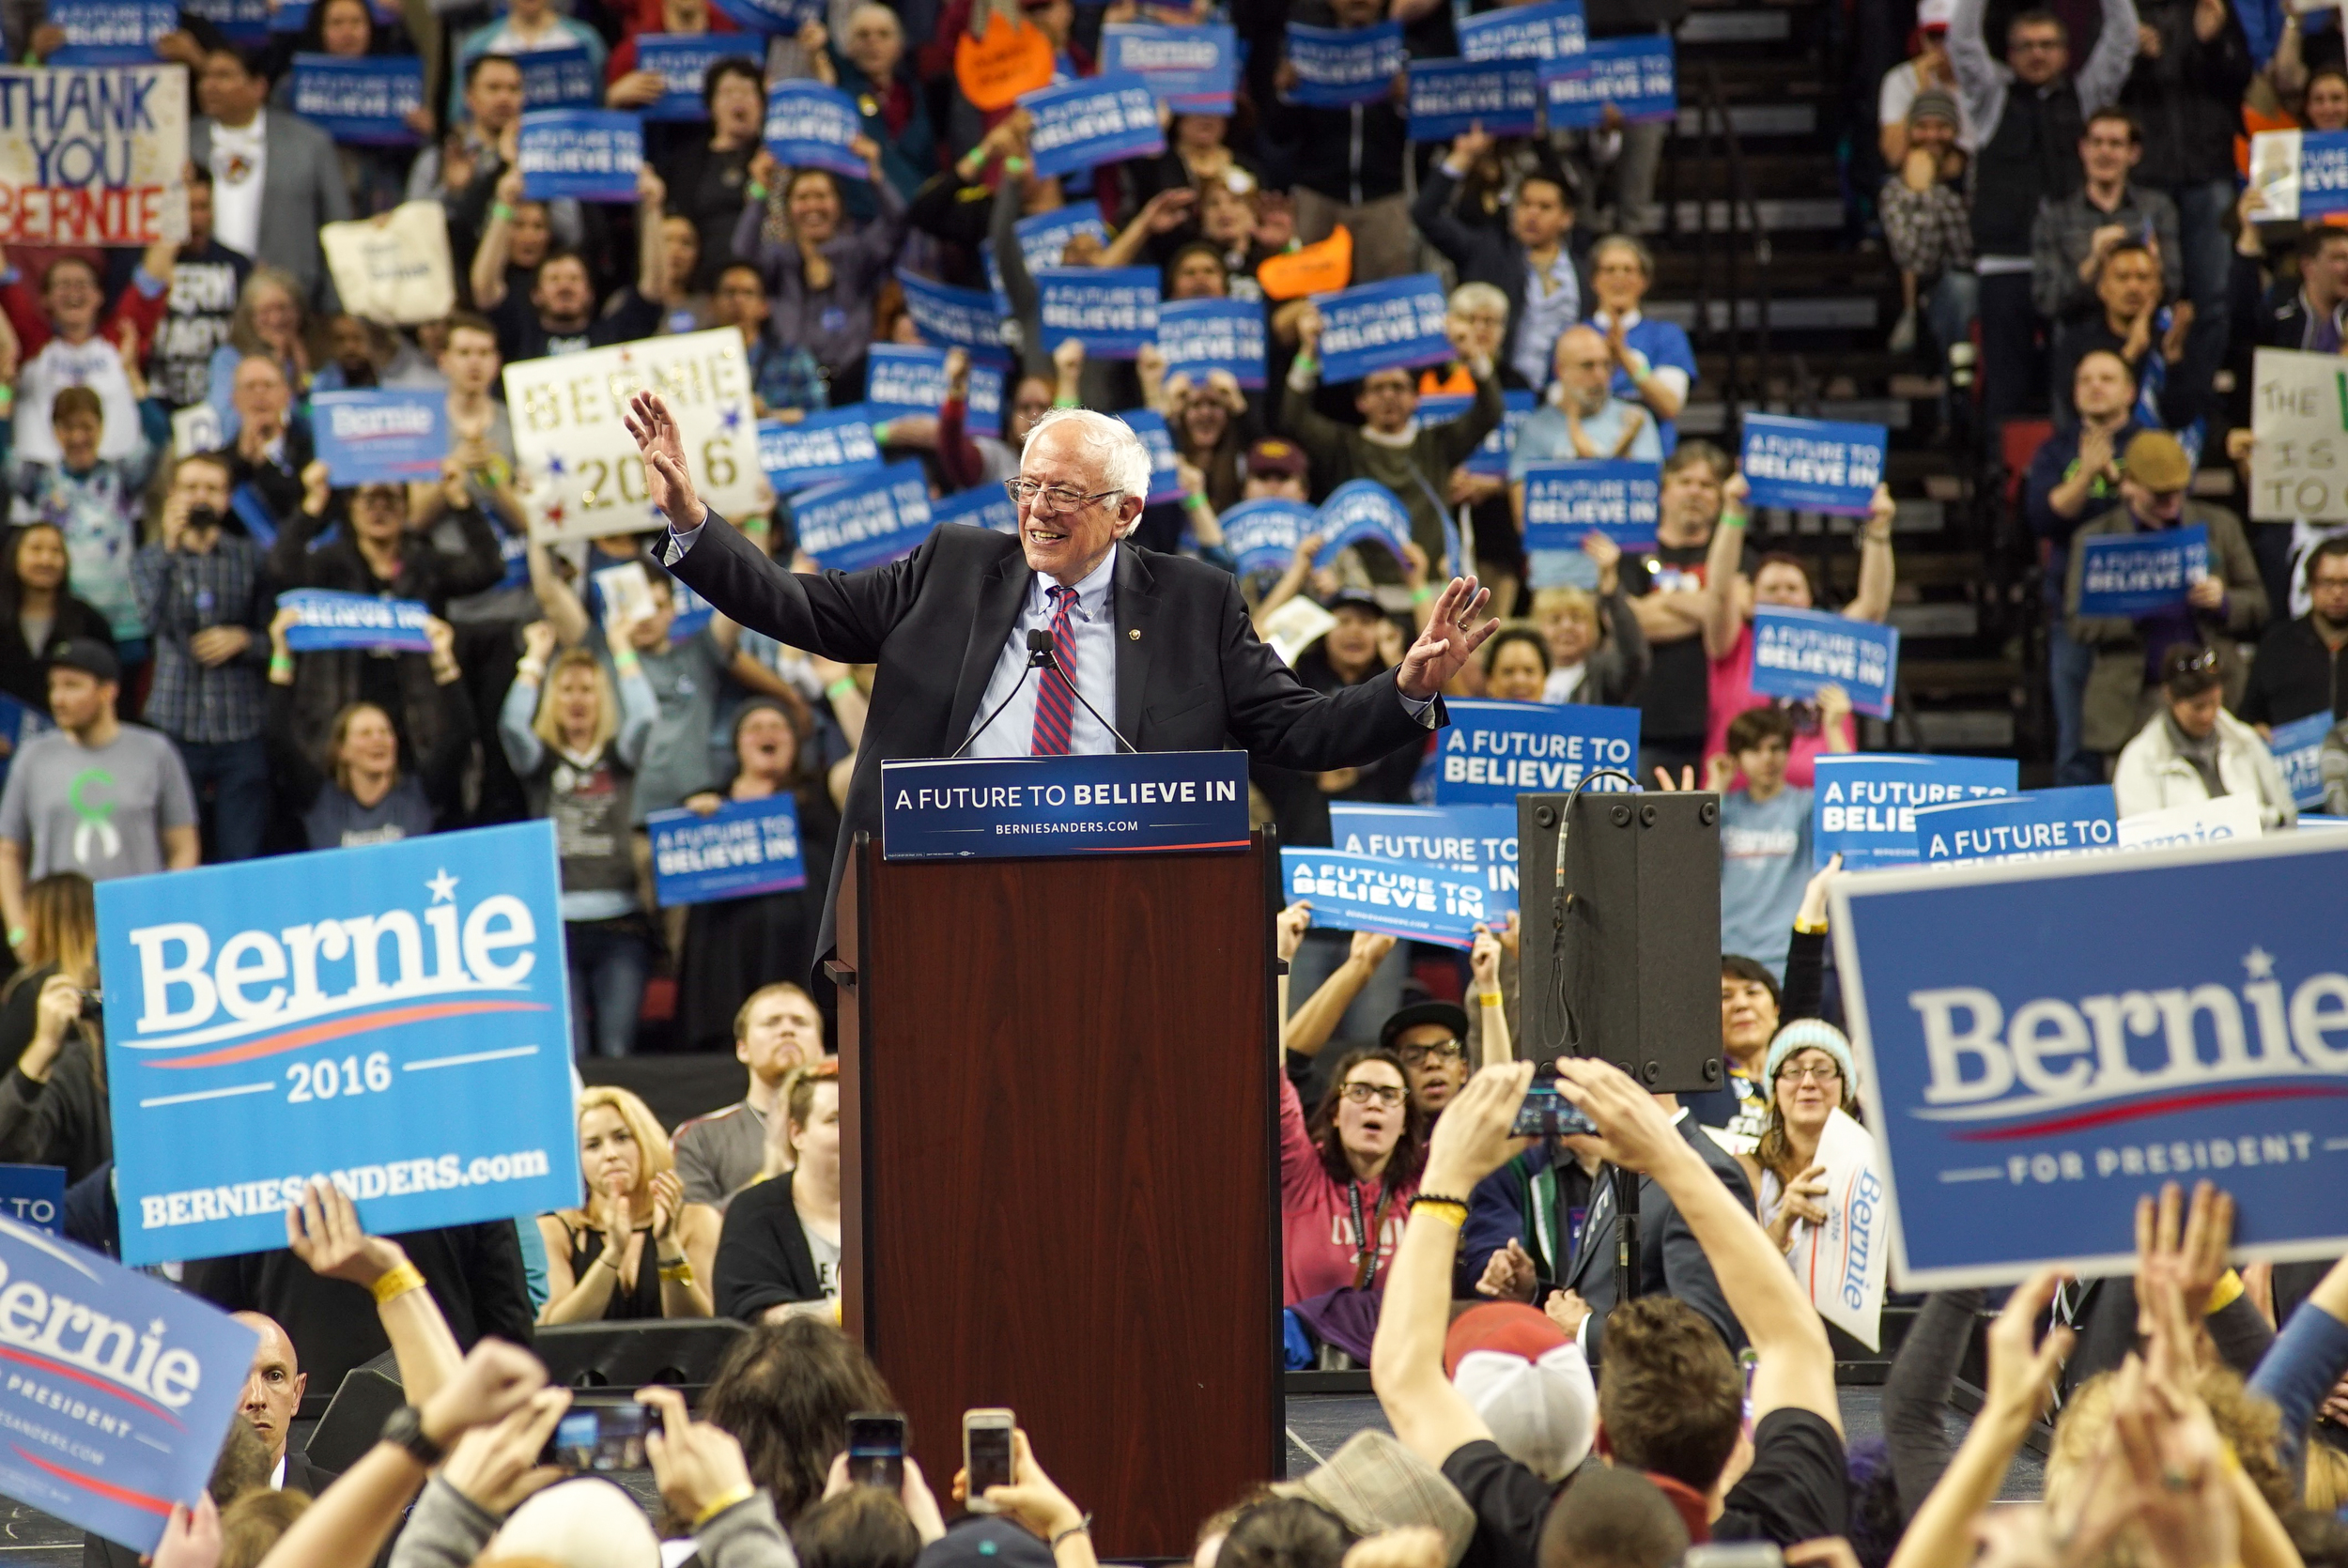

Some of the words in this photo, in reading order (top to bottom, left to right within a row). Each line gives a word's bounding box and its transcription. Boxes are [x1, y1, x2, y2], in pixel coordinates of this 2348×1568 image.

[0, 76, 158, 131] THANK
[30, 136, 132, 189] YOU
[0, 187, 164, 242] BERNIE
[2259, 379, 2320, 419] THE
[1745, 451, 1846, 486] BELIEVE
[1847, 463, 1879, 490] IN
[1766, 435, 1846, 460] FUTURE
[1849, 443, 1881, 467] TO
[2274, 438, 2337, 470] IS
[576, 436, 738, 513] 206
[1527, 500, 1627, 525] BELIEVE
[2263, 476, 2329, 515] TO
[1778, 625, 1857, 655] FUTURE
[1755, 642, 1858, 681] BELIEVE
[1857, 659, 1886, 688] IN
[1446, 729, 1467, 752] A
[1473, 730, 1583, 761] FUTURE
[1589, 737, 1631, 765] TO
[1444, 755, 1583, 791] BELIEVE
[1824, 780, 1845, 805] A
[895, 790, 913, 810] A
[919, 786, 1022, 810] FUTURE
[1028, 785, 1066, 807] TO
[1074, 781, 1197, 806] BELIEVE
[1206, 780, 1236, 802] IN
[673, 818, 758, 850] FUTURE
[761, 814, 796, 837] TO
[996, 820, 1138, 835] BERNIESANDERS.COM
[1822, 807, 1917, 833] BELIE
[1929, 833, 1951, 859] A
[1955, 821, 2068, 853] FUTURE
[2072, 819, 2111, 845] TO
[658, 838, 764, 876] BELIEVE
[764, 835, 798, 861] IN
[1344, 833, 1365, 855] A
[1369, 833, 1478, 861] FUTURE
[1481, 838, 1519, 862] TO
[1292, 876, 1439, 913] BELIEVE
[1445, 897, 1485, 920] IN
[1293, 863, 1315, 879] A
[1320, 865, 1436, 894] FUTURE
[1440, 881, 1484, 902] TO
[130, 892, 537, 1034] Bernie
[1907, 971, 2348, 1105] Bernie
[286, 1052, 393, 1104] 2016
[2007, 1153, 2084, 1185] FOR
[2095, 1131, 2314, 1176] PRESIDENT
[140, 1149, 550, 1230] BERNIESNDERS.com
[10, 1197, 55, 1223] TO
[1843, 1165, 1883, 1312] Bernie
[0, 1256, 201, 1408] ernie
[7, 1372, 132, 1439] PRESIDENT
